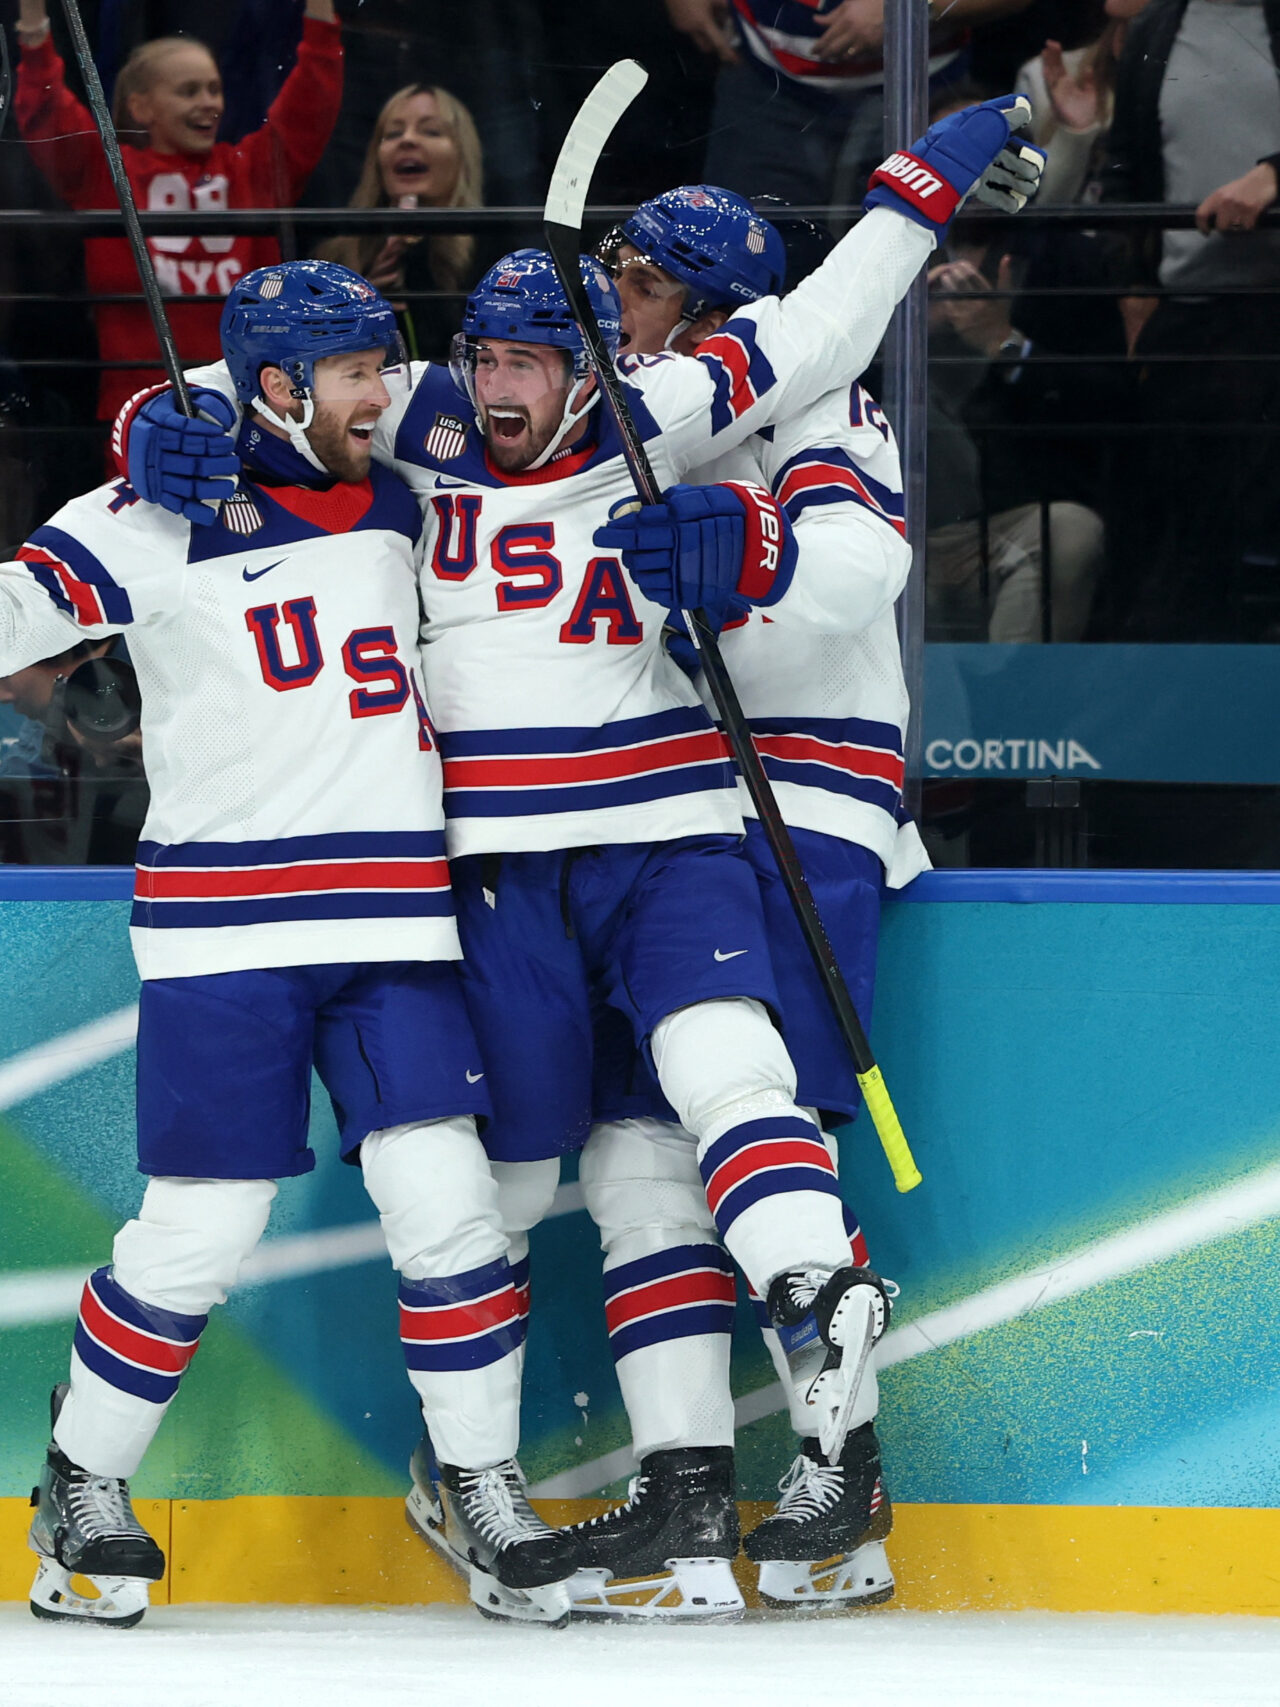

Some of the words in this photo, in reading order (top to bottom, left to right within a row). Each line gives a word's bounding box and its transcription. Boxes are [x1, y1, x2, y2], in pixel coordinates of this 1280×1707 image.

[496, 271, 522, 288] 21
[597, 318, 619, 330] CCM
[439, 416, 464, 432] USA
[431, 493, 644, 645] USA
[925, 739, 1102, 770] CORTINA
[675, 1464, 709, 1476] TRUE
[712, 1599, 739, 1607] TRUE
